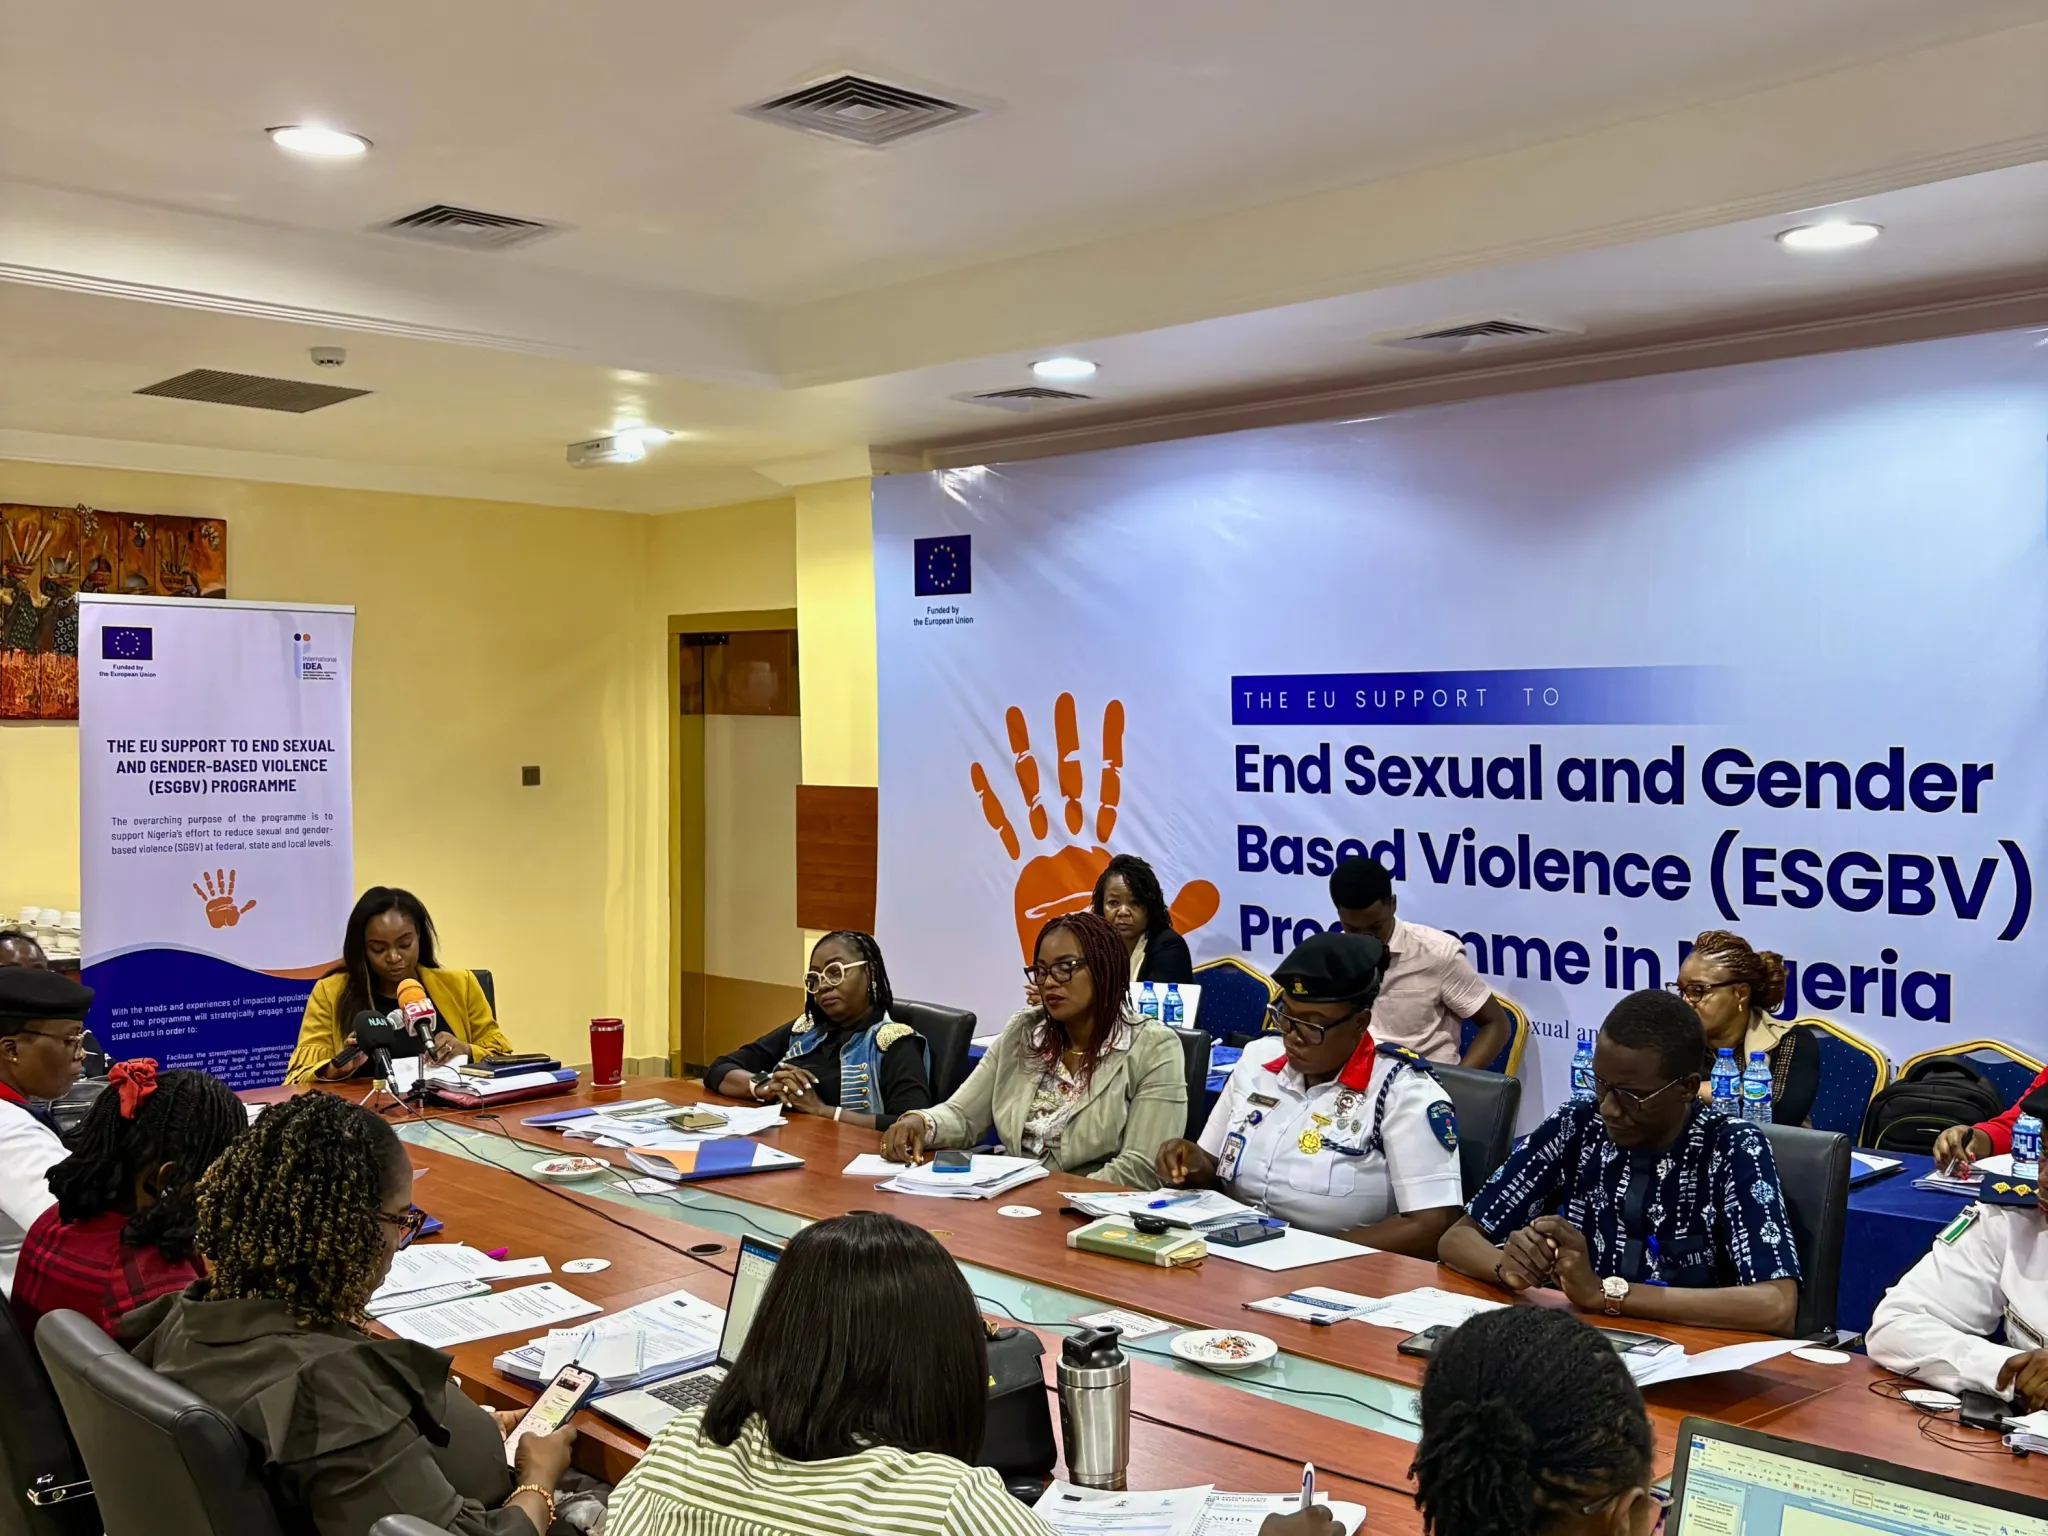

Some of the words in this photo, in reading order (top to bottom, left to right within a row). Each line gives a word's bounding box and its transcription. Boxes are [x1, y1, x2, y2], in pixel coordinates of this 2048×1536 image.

[927, 606, 950, 614] Funded
[952, 606, 959, 615] by
[924, 617, 954, 626] European
[955, 616, 974, 624] Union
[1244, 690, 1288, 710] THE
[1307, 690, 1336, 709] EU
[1356, 688, 1487, 708] SUPPORT
[1524, 687, 1560, 706] TO
[107, 740, 136, 753] THE
[140, 740, 156, 752] EU
[161, 740, 226, 752] SUPPORT
[231, 740, 248, 752] TO
[252, 740, 279, 752] END
[283, 740, 335, 752] SEXUAL
[116, 760, 146, 774] AND
[150, 760, 258, 773] GENDER-BASED
[262, 759, 328, 772] VIOLENCE
[1235, 743, 1331, 795] End
[1344, 744, 1542, 802] Sexual
[1557, 745, 1684, 806] and
[1702, 747, 1994, 814] Gender
[149, 780, 207, 794] (ESGBV)
[212, 779, 296, 793] PROGRAMME
[112, 817, 127, 826] The
[134, 816, 182, 826] overarching
[188, 816, 222, 825] purpose
[262, 814, 306, 824] programme
[112, 831, 144, 841] support
[147, 830, 182, 840] Nigeria's
[185, 829, 210, 838] effort
[224, 828, 253, 836] reduce
[256, 828, 282, 836] sexual
[302, 827, 333, 836] gender-
[112, 845, 136, 854] based
[139, 843, 173, 854] violence
[174, 842, 204, 853] (SGBV)
[205, 843, 213, 851] at
[216, 841, 247, 851] federal,
[249, 841, 270, 850] state
[272, 840, 286, 849] and
[288, 840, 306, 848] local
[308, 839, 333, 848] levels.
[1418, 828, 1691, 902] Violence
[1710, 829, 2032, 941] (ESGBV)
[1604, 926, 1660, 990] in
[112, 1008, 129, 1016] With
[186, 999, 230, 1010] experiences
[233, 998, 240, 1006] of
[243, 996, 275, 1006] impacted
[278, 994, 310, 1003] populatio
[148, 1014, 191, 1026] programme
[210, 1010, 254, 1020] strategically
[258, 1007, 283, 1017] engage
[132, 1030, 154, 1038] actors
[166, 1027, 186, 1035] order
